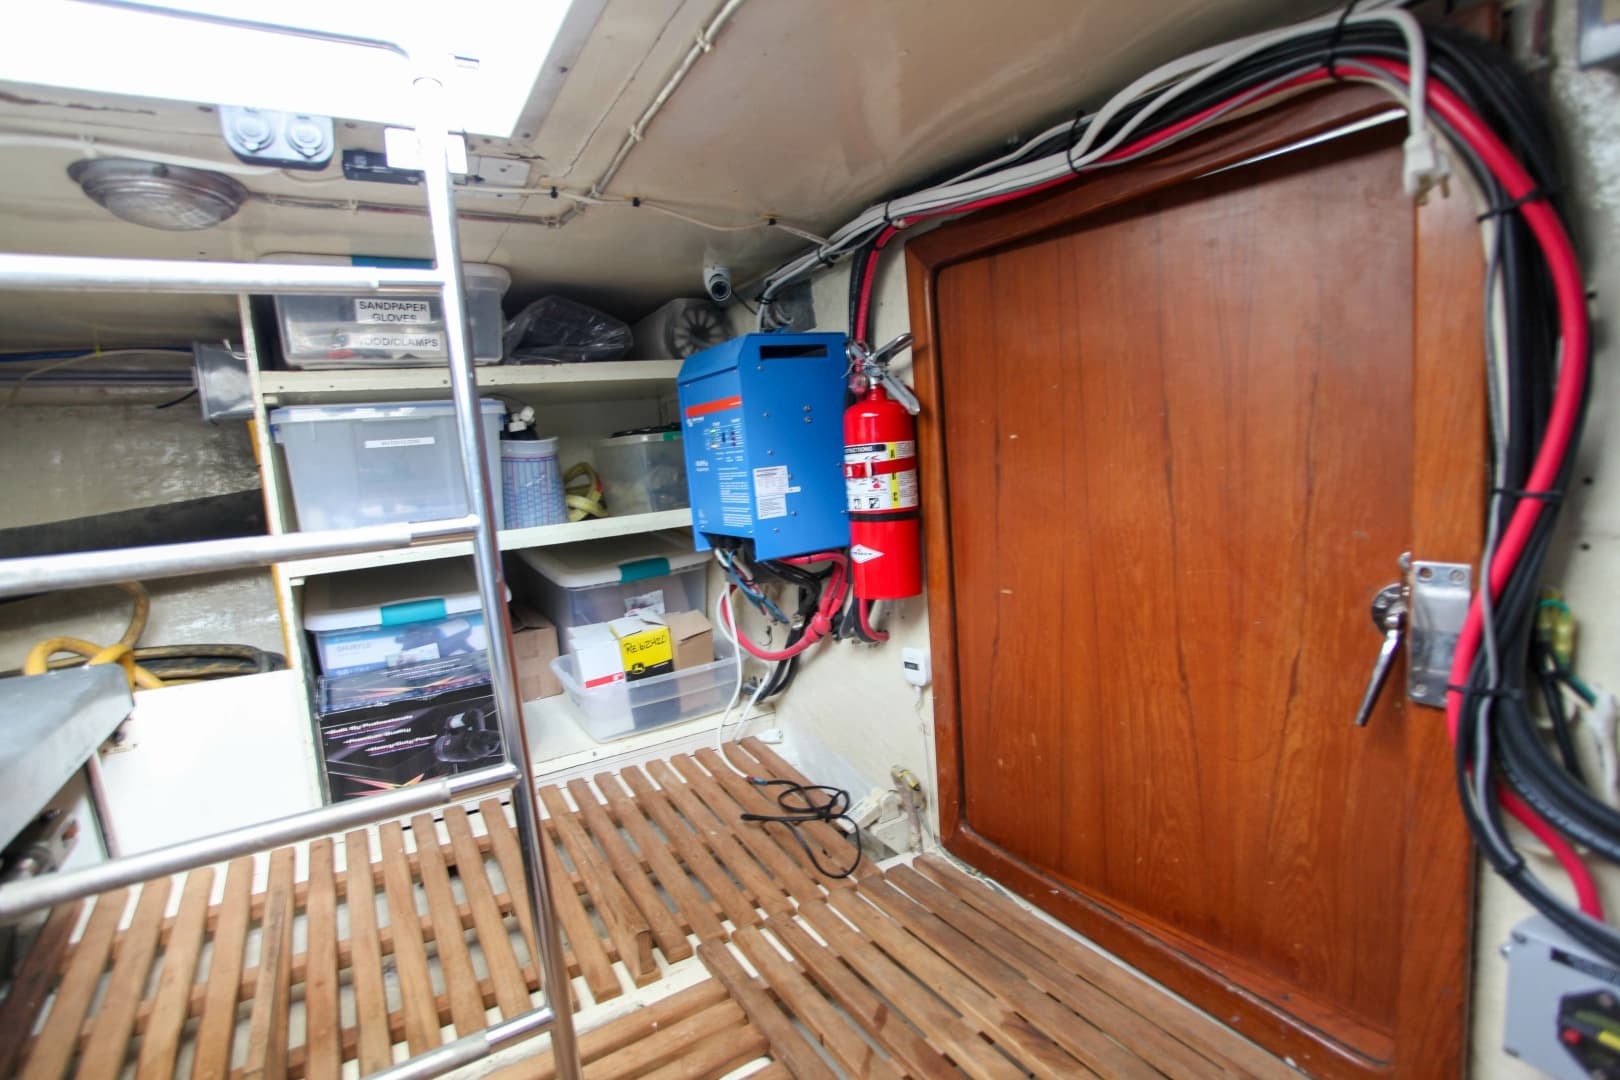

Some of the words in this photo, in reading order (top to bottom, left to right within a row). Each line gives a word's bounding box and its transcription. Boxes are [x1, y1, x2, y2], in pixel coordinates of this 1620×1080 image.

[360, 301, 427, 312] SANDPAPER
[372, 313, 416, 323] GLOVES
[356, 335, 439, 347] OOD/CLAMPS
